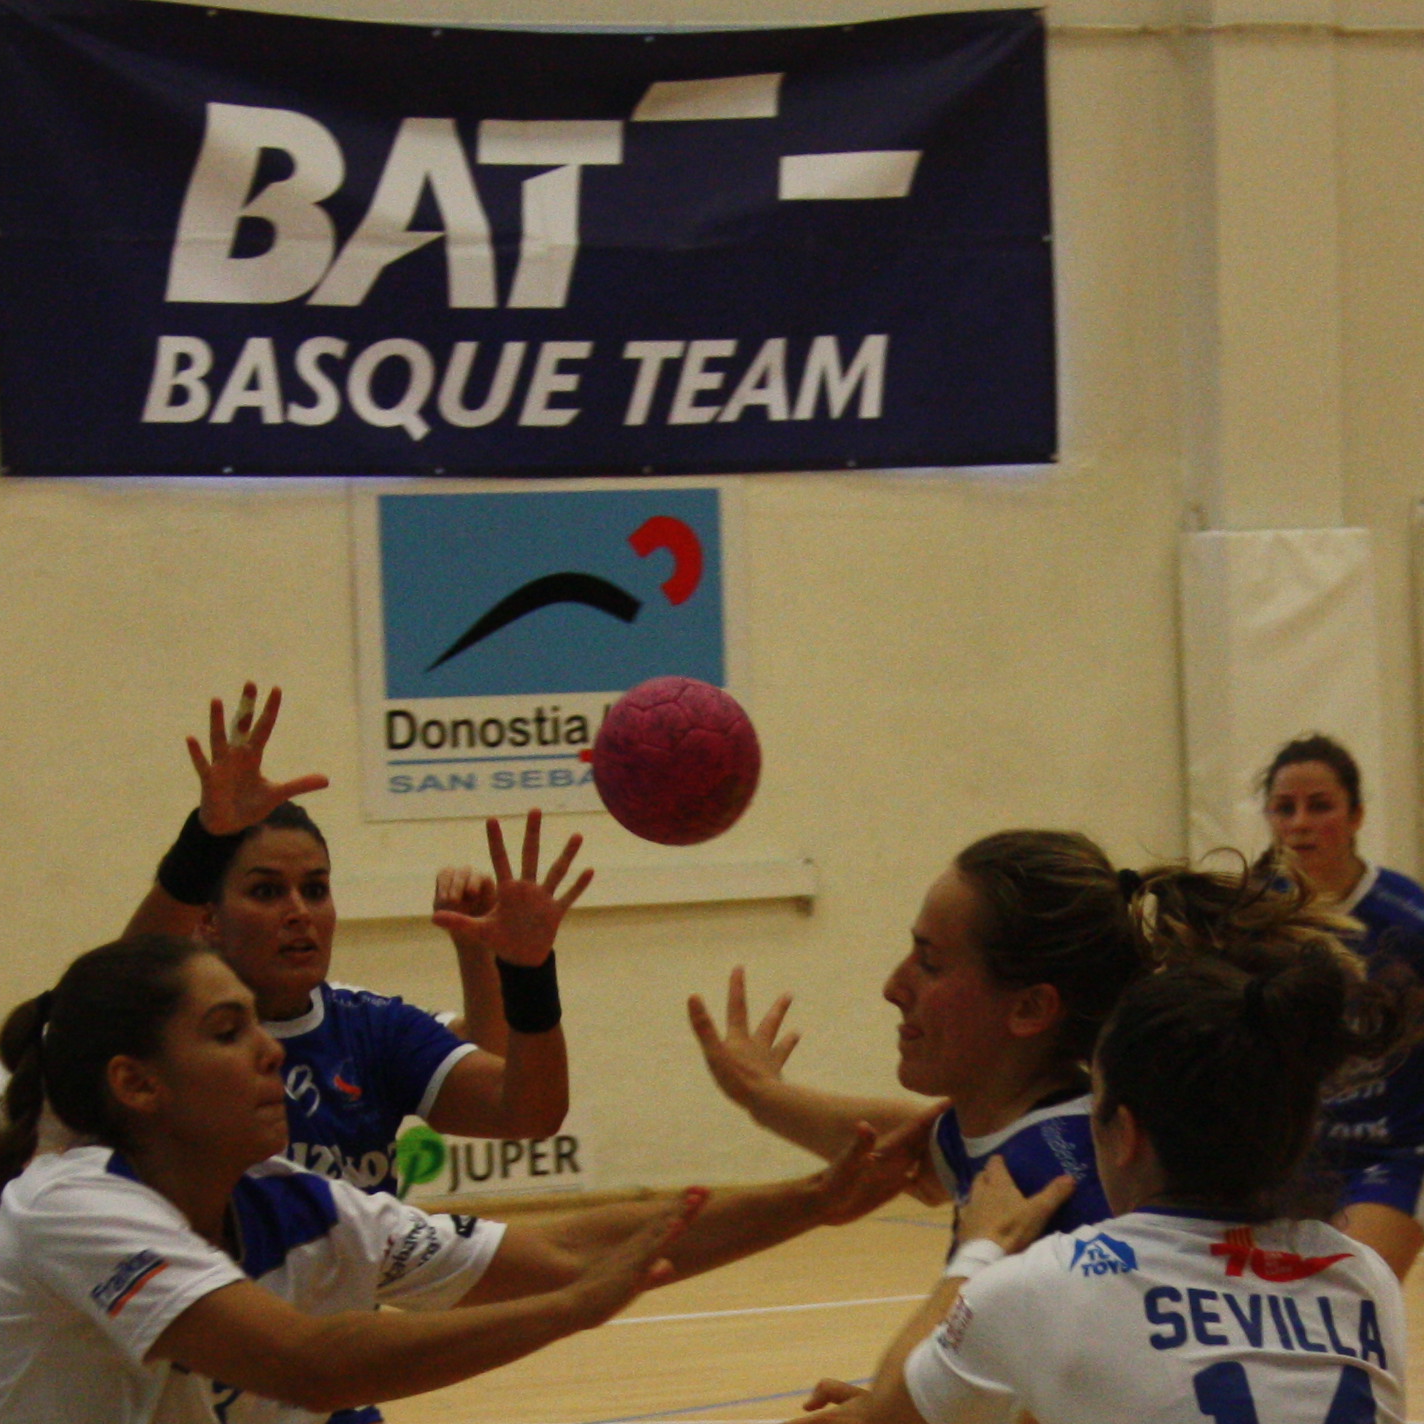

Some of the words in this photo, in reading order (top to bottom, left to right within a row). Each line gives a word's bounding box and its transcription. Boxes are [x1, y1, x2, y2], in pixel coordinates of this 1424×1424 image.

[165, 101, 623, 308] BAT
[142, 334, 593, 442] BASQUE
[622, 333, 889, 427] TEAM
[385, 705, 590, 751] Donostia
[389, 774, 478, 794] SAN
[1143, 1285, 1387, 1371] SEVILLA
